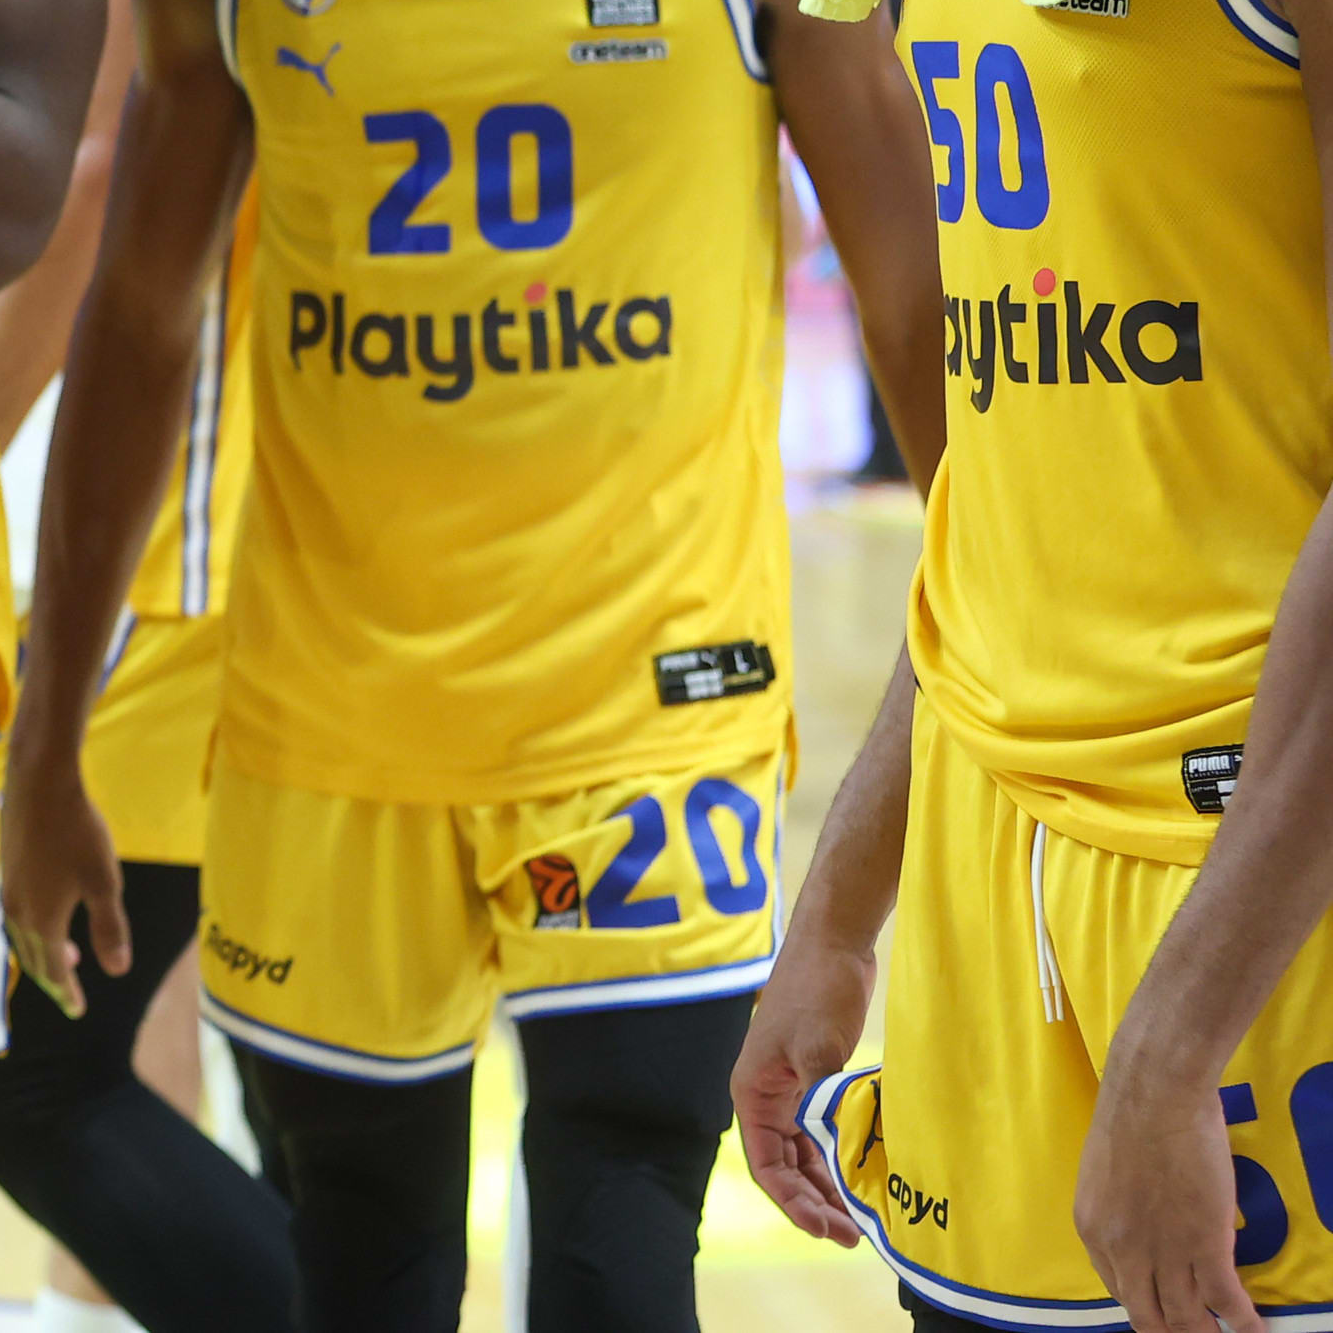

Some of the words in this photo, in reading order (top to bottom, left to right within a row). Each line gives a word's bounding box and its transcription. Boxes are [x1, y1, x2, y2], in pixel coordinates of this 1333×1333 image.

[364, 104, 573, 255] 20
[911, 41, 1050, 230] 50
[290, 283, 672, 402] Playtika
[944, 268, 1203, 414] aytika
[1188, 755, 1230, 773] PUMA
[585, 778, 767, 928] 20
[888, 1173, 949, 1231] apyd
